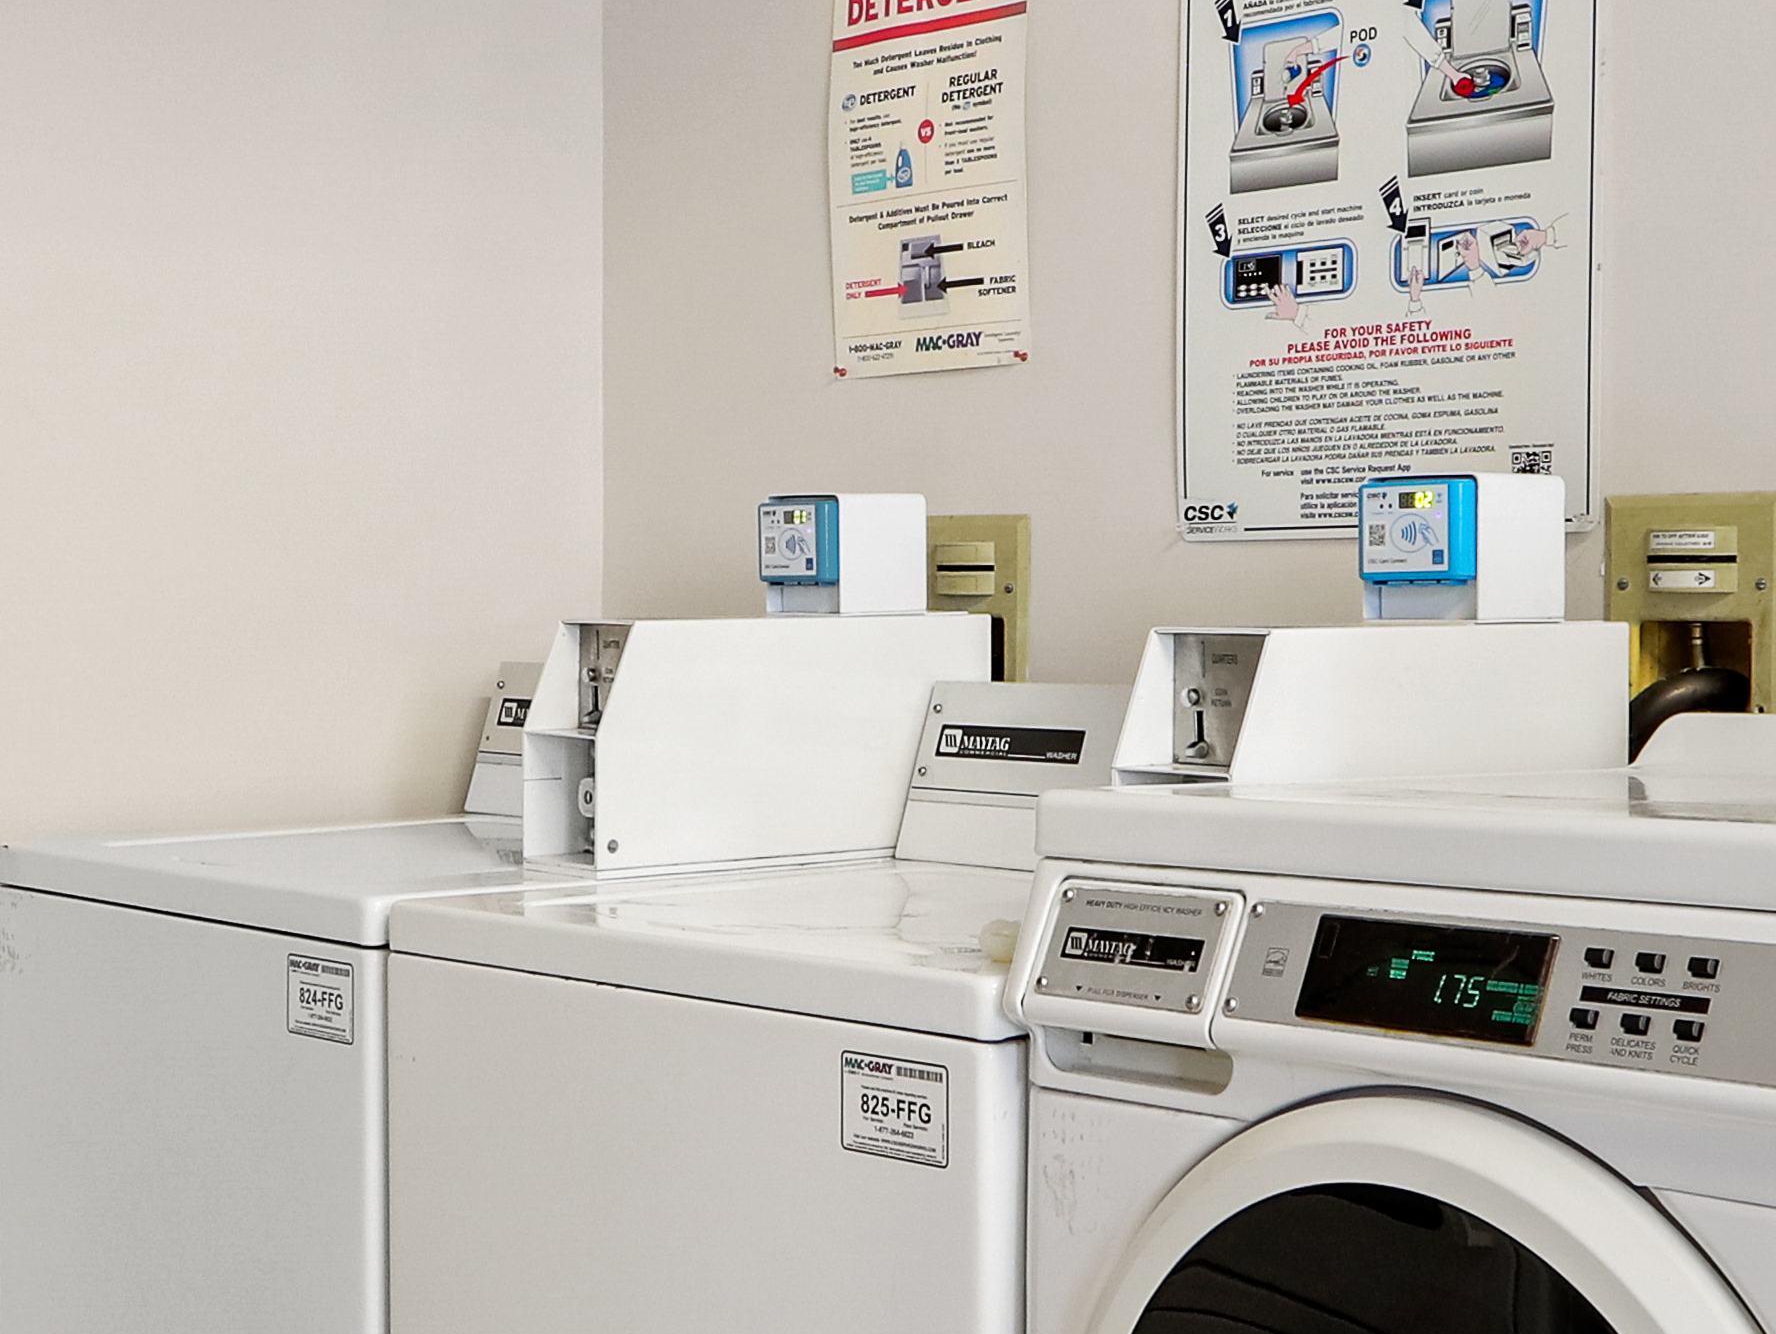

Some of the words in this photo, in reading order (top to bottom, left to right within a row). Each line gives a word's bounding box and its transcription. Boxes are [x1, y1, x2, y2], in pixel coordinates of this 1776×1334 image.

[1224, 9, 1234, 26] 1
[1350, 27, 1377, 43] POD
[949, 69, 997, 87] REGULAR
[860, 86, 916, 106] DETERGENT
[942, 83, 1003, 103] DETERGENT
[920, 125, 932, 136] VS
[1390, 198, 1401, 215] 4
[1215, 224, 1225, 241] 3
[967, 239, 995, 250] BLEACH
[990, 275, 1016, 284] FABRIC
[978, 286, 1016, 297] SOFTENER
[1324, 329, 1347, 339] FOR
[1352, 326, 1383, 337] YOUR
[1386, 320, 1432, 334] SAFETY
[1288, 341, 1330, 354] PLEASE
[1334, 339, 1369, 350] AVOID
[1374, 336, 1396, 347] THE
[1400, 329, 1472, 345] FOLLOWING
[1184, 505, 1224, 521] CSC
[961, 735, 1010, 751] MAYTAG
[1047, 752, 1077, 760] WASHER
[1086, 938, 1137, 955] MAYTAG
[1582, 973, 1613, 981] WHITES
[1631, 977, 1666, 987] COLORS
[1683, 982, 1721, 993] BRIGHTS
[299, 987, 343, 1010] 824-FFG
[1607, 992, 1638, 1002] FABRIC
[1640, 996, 1682, 1007] SETTINGS
[1569, 1033, 1593, 1042] PERM
[1611, 1038, 1656, 1050] DELICATES
[1566, 1044, 1593, 1054] PRESS
[1610, 1049, 1626, 1058] AND
[1628, 1051, 1653, 1060] KNITS
[1673, 1045, 1700, 1055] QUICK
[1670, 1055, 1698, 1065] CYCLE
[861, 1094, 931, 1124] 825-FFG
